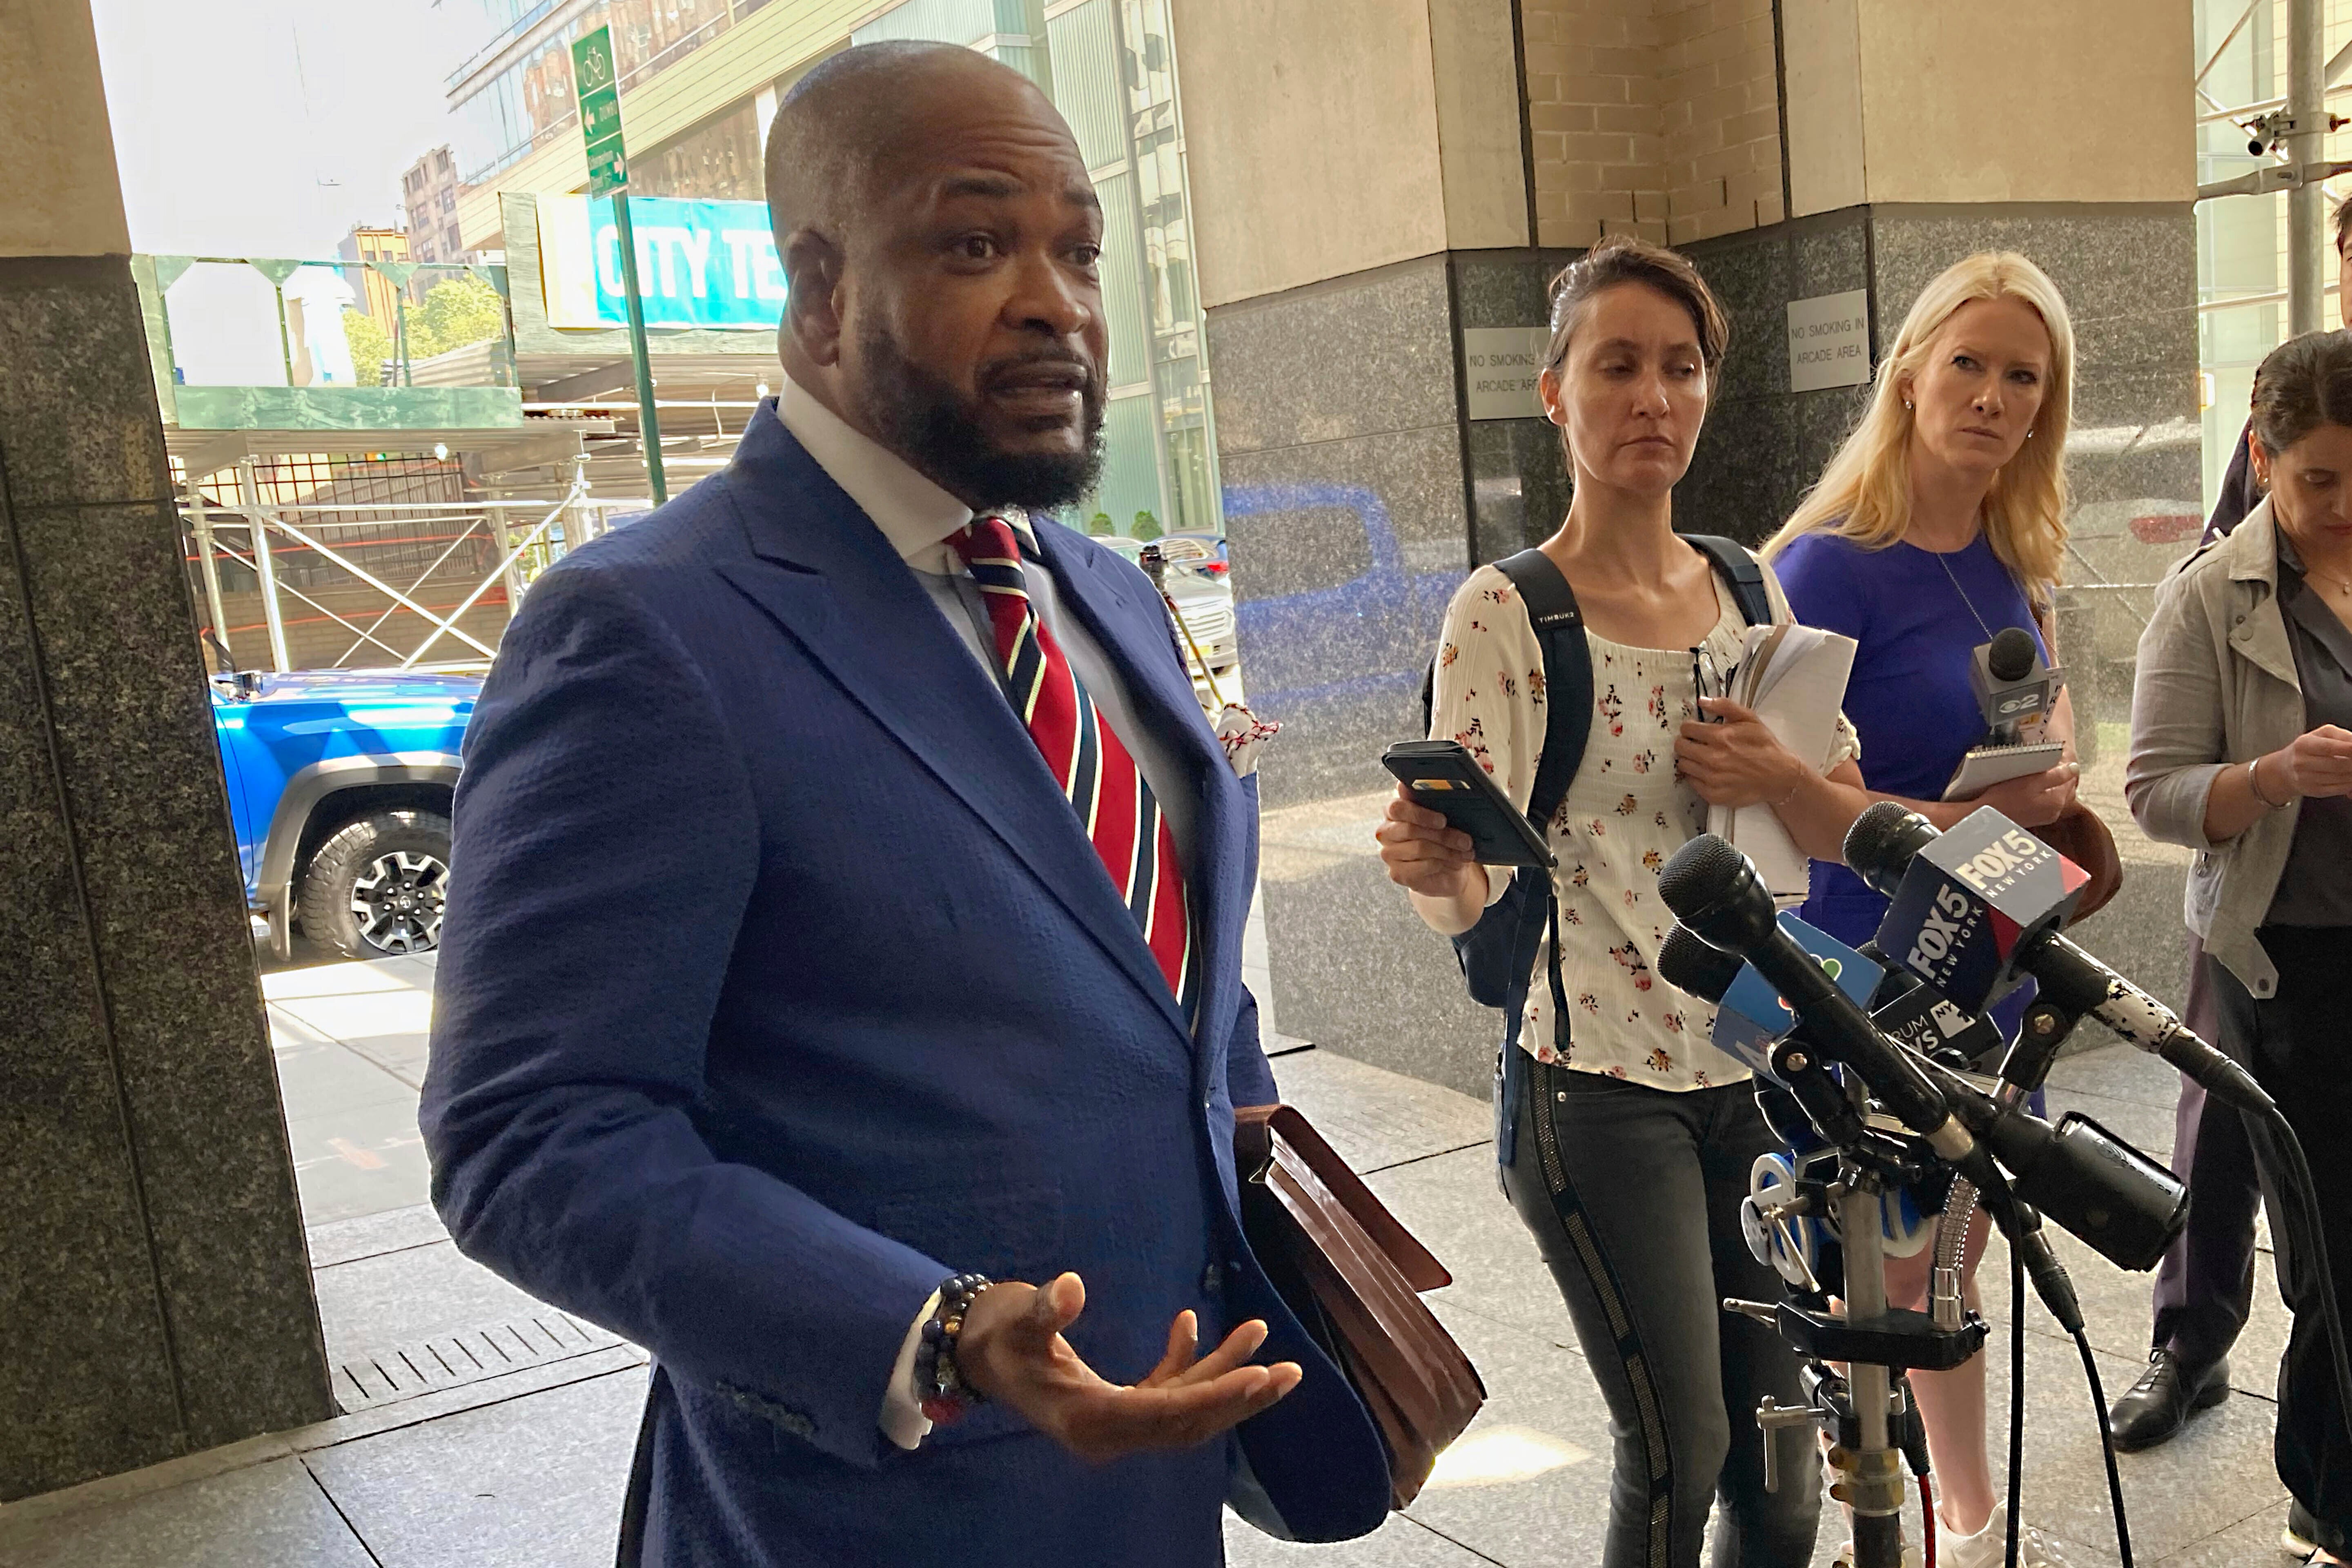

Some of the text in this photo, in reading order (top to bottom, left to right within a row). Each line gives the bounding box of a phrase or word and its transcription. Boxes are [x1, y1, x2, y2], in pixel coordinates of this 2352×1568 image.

[597, 225, 711, 298] CITY
[1791, 317, 1864, 340] NO SMOKING IN
[1469, 353, 1535, 367] NO SMOKING
[1797, 345, 1862, 364] ARCADE AREA
[1476, 378, 1541, 393] ARCADE AR
[1539, 612, 1574, 623] TIMBUK2
[1986, 849, 2051, 898] NEW YORK
[1936, 904, 1983, 988] NEW YORK
